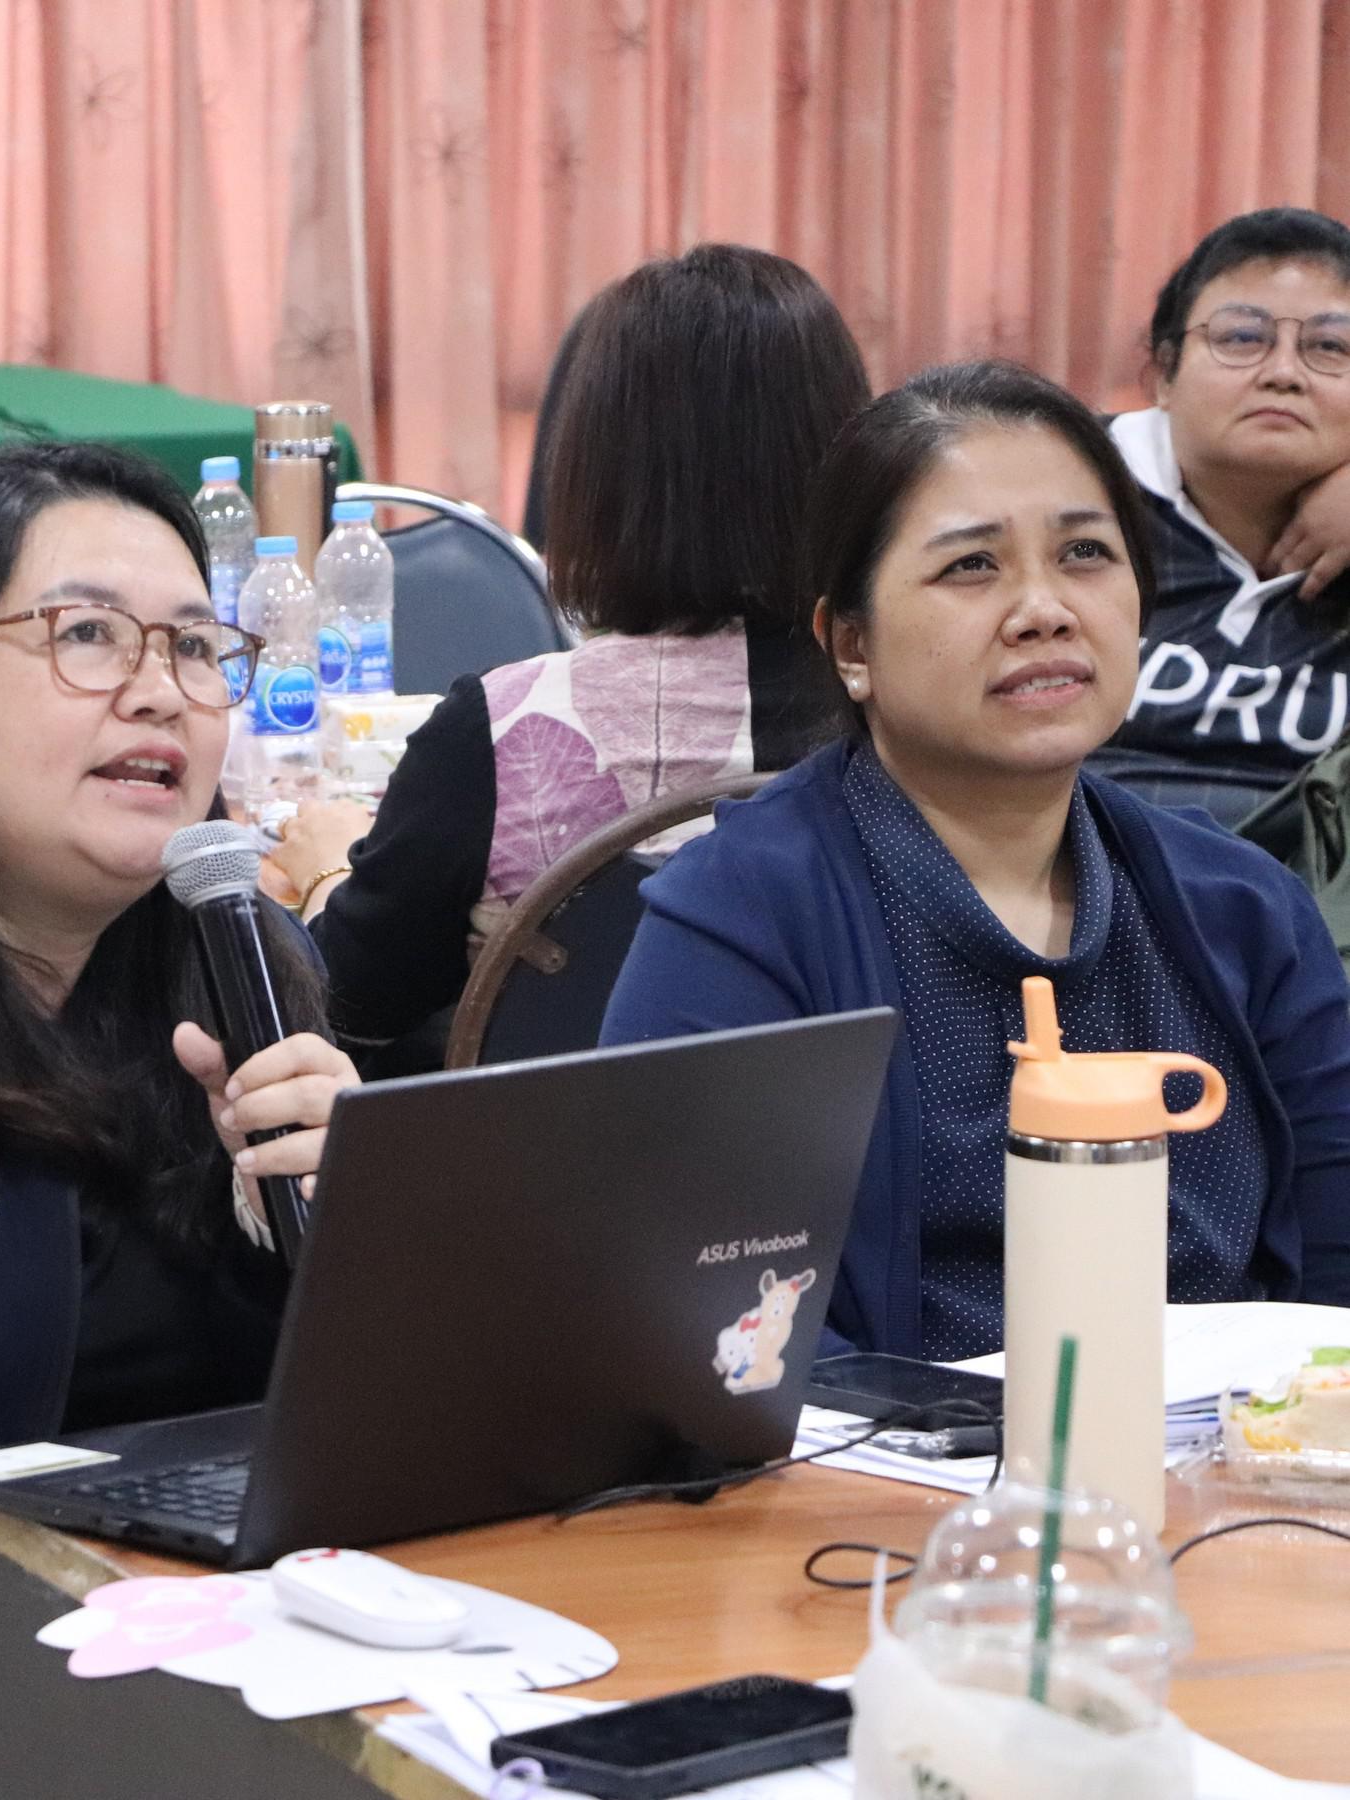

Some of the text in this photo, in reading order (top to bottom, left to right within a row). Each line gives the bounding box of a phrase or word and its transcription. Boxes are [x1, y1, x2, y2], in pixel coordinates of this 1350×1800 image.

[1126, 637, 1348, 755] PRU
[696, 1229, 810, 1267] ASUS Vivobook
